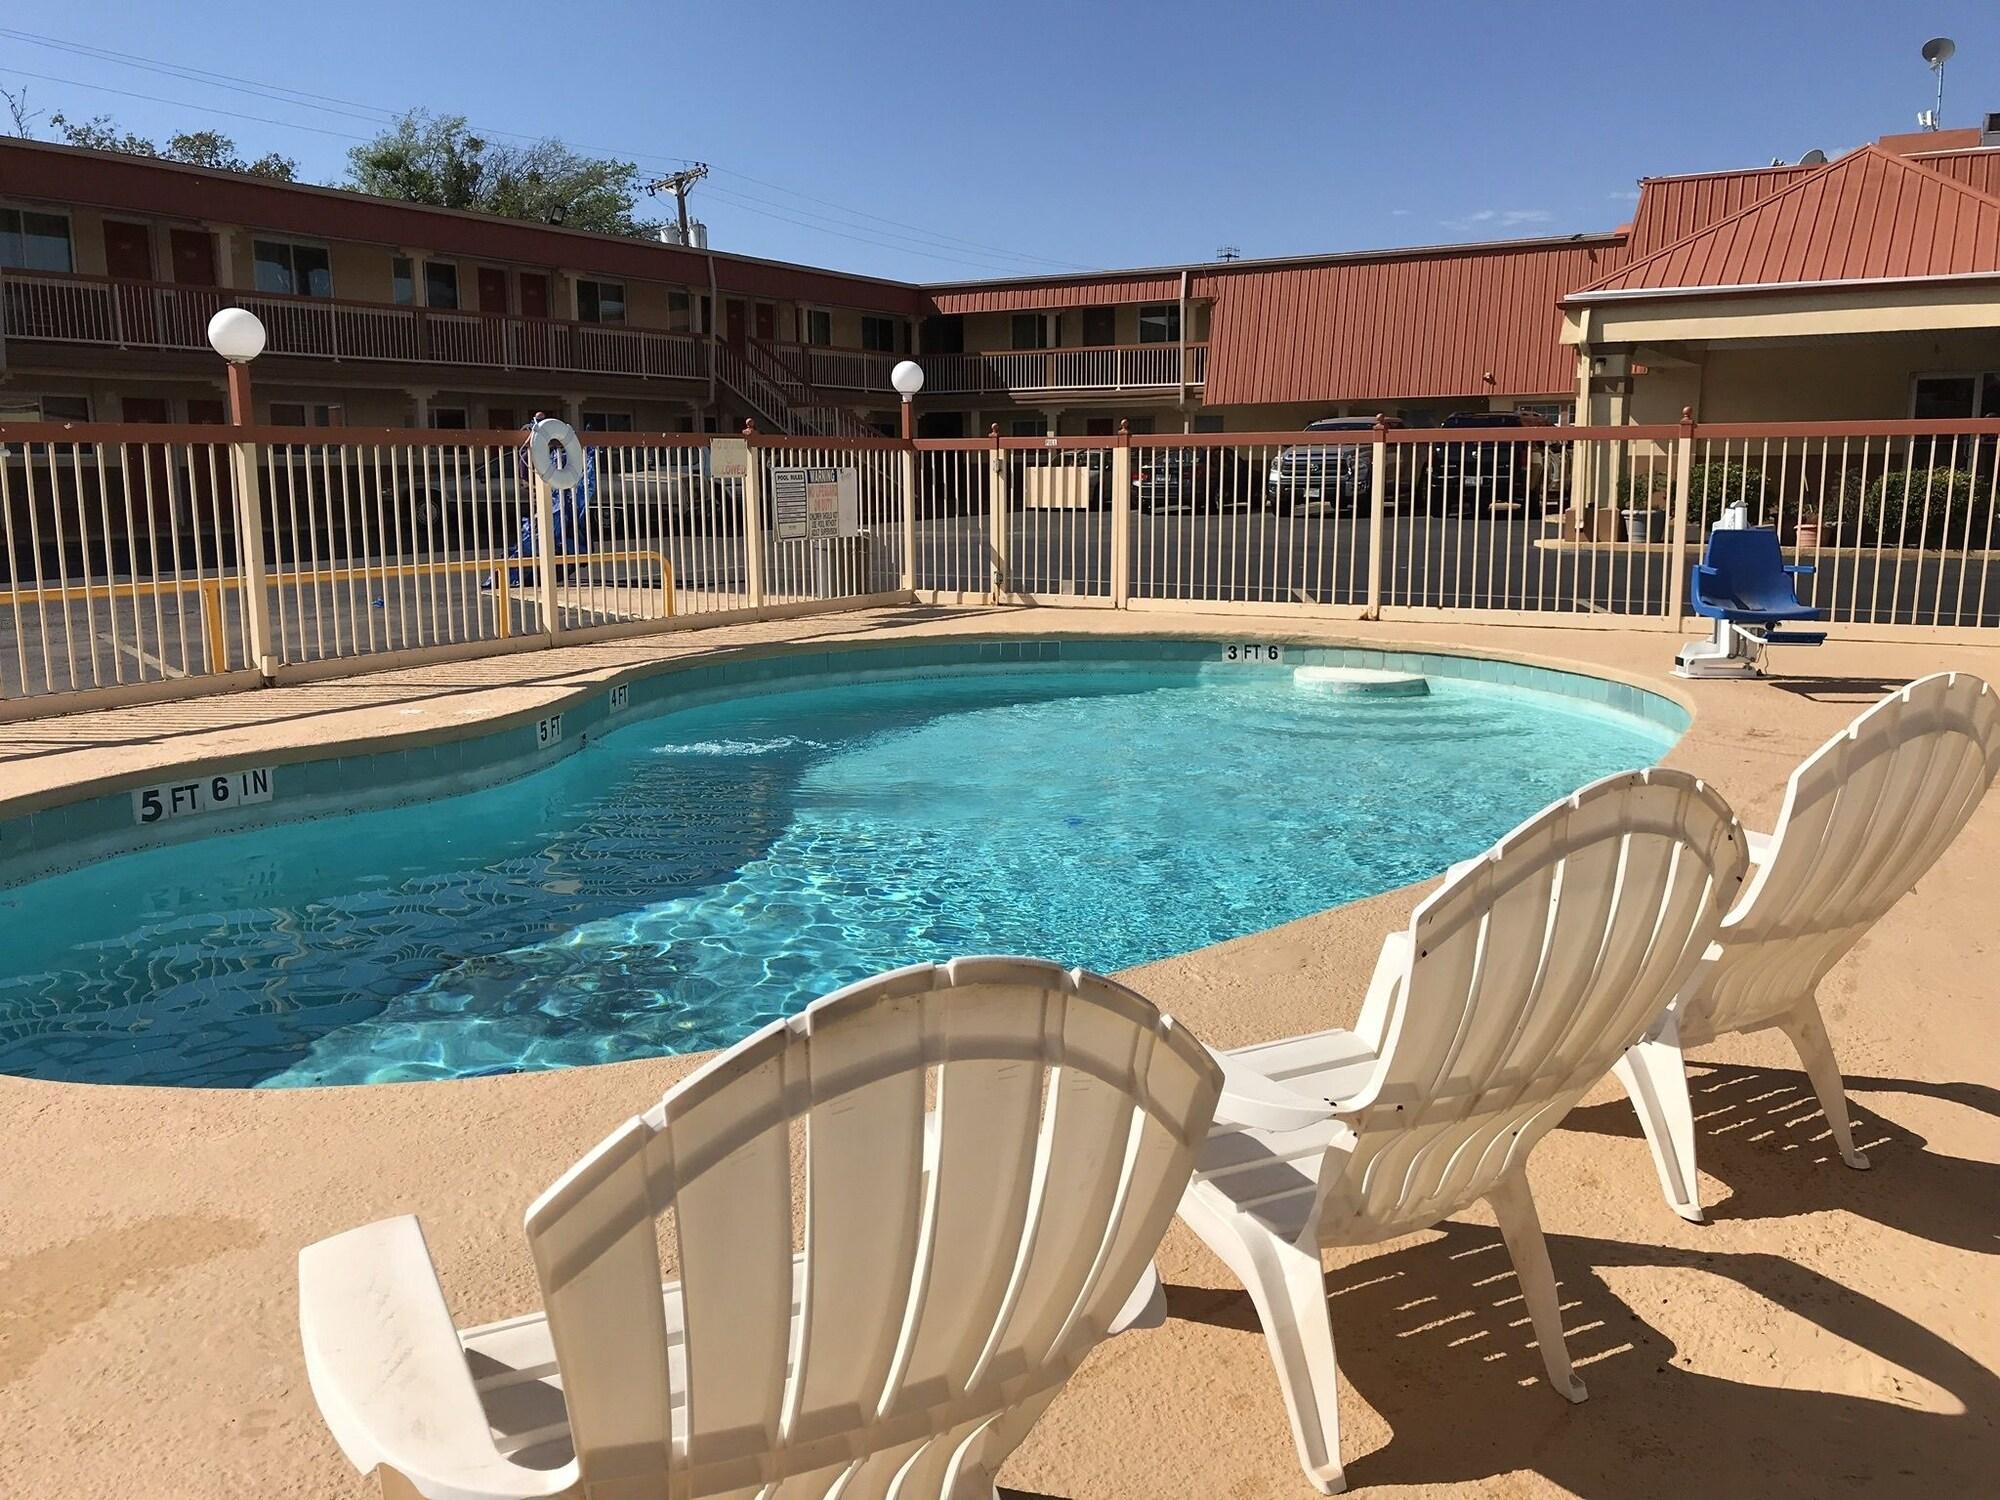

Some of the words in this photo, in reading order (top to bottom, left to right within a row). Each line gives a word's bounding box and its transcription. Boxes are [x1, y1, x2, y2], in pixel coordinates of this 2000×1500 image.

[810, 469, 835, 482] WARNING
[1228, 645, 1238, 660] 3
[1244, 645, 1261, 659] FT
[1268, 645, 1278, 660] 6
[611, 689, 616, 706] 4
[619, 685, 627, 704] FT
[540, 720, 547, 741] 5
[551, 716, 560, 738] FT
[142, 789, 163, 822] 5
[171, 784, 199, 813] FT
[212, 777, 229, 801] 6
[242, 769, 267, 796] IN
